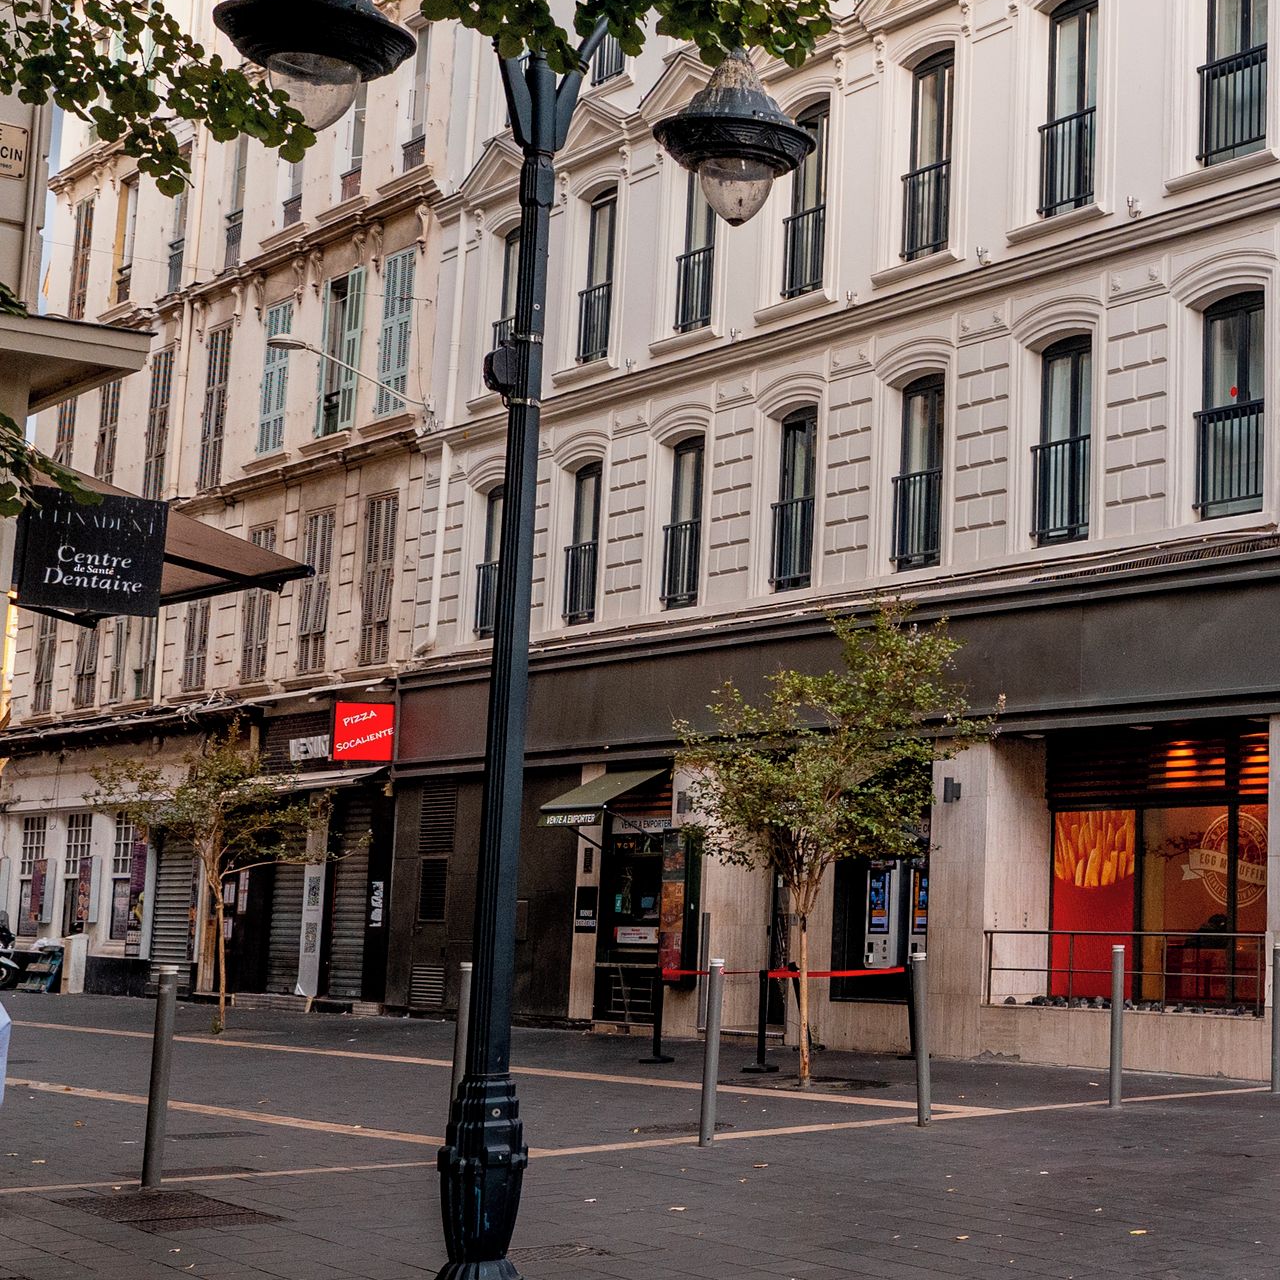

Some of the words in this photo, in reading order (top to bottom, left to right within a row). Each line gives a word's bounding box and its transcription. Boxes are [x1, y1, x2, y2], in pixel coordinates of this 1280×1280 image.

[57, 545, 132, 568] Centre
[74, 565, 85, 573] de
[87, 565, 114, 575] Santé
[44, 566, 142, 593] Dentaire
[343, 710, 377, 726] PIZZA
[336, 727, 394, 752] SOCALIENTE
[546, 815, 562, 825] VENTE
[567, 813, 596, 824] EMPORTER
[643, 819, 672, 829] EMPORTER
[1200, 854, 1216, 866] EGG
